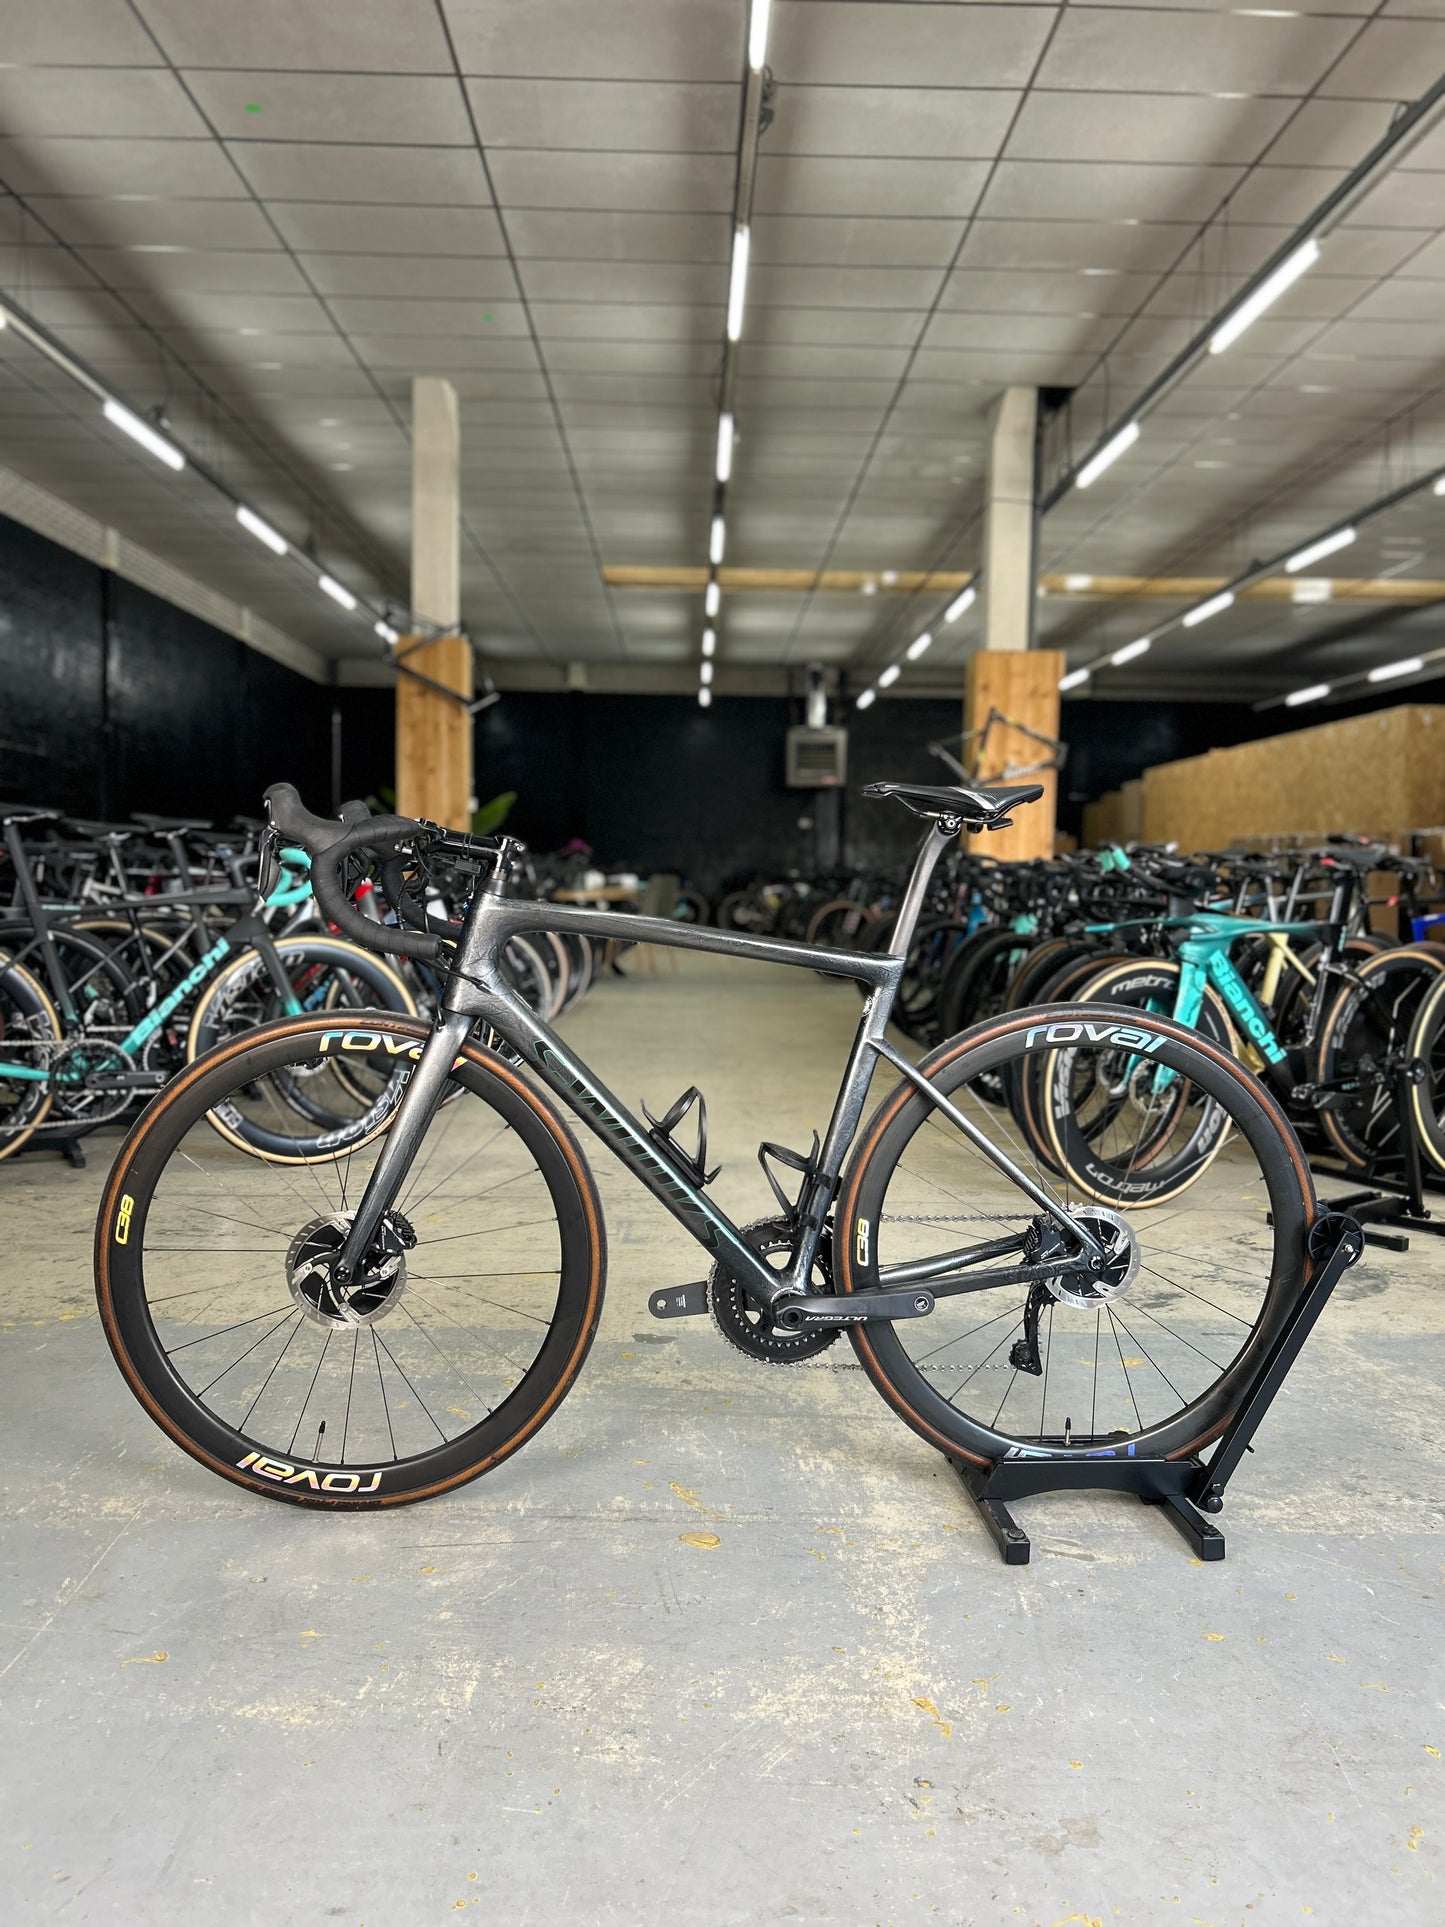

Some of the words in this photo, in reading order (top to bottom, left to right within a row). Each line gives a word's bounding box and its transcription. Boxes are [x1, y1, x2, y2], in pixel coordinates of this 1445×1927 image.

[131, 936, 231, 1049] Bianchi
[1209, 949, 1288, 1064] Bianchi
[1025, 1024, 1168, 1053] roval
[236, 1451, 382, 1493] roval
